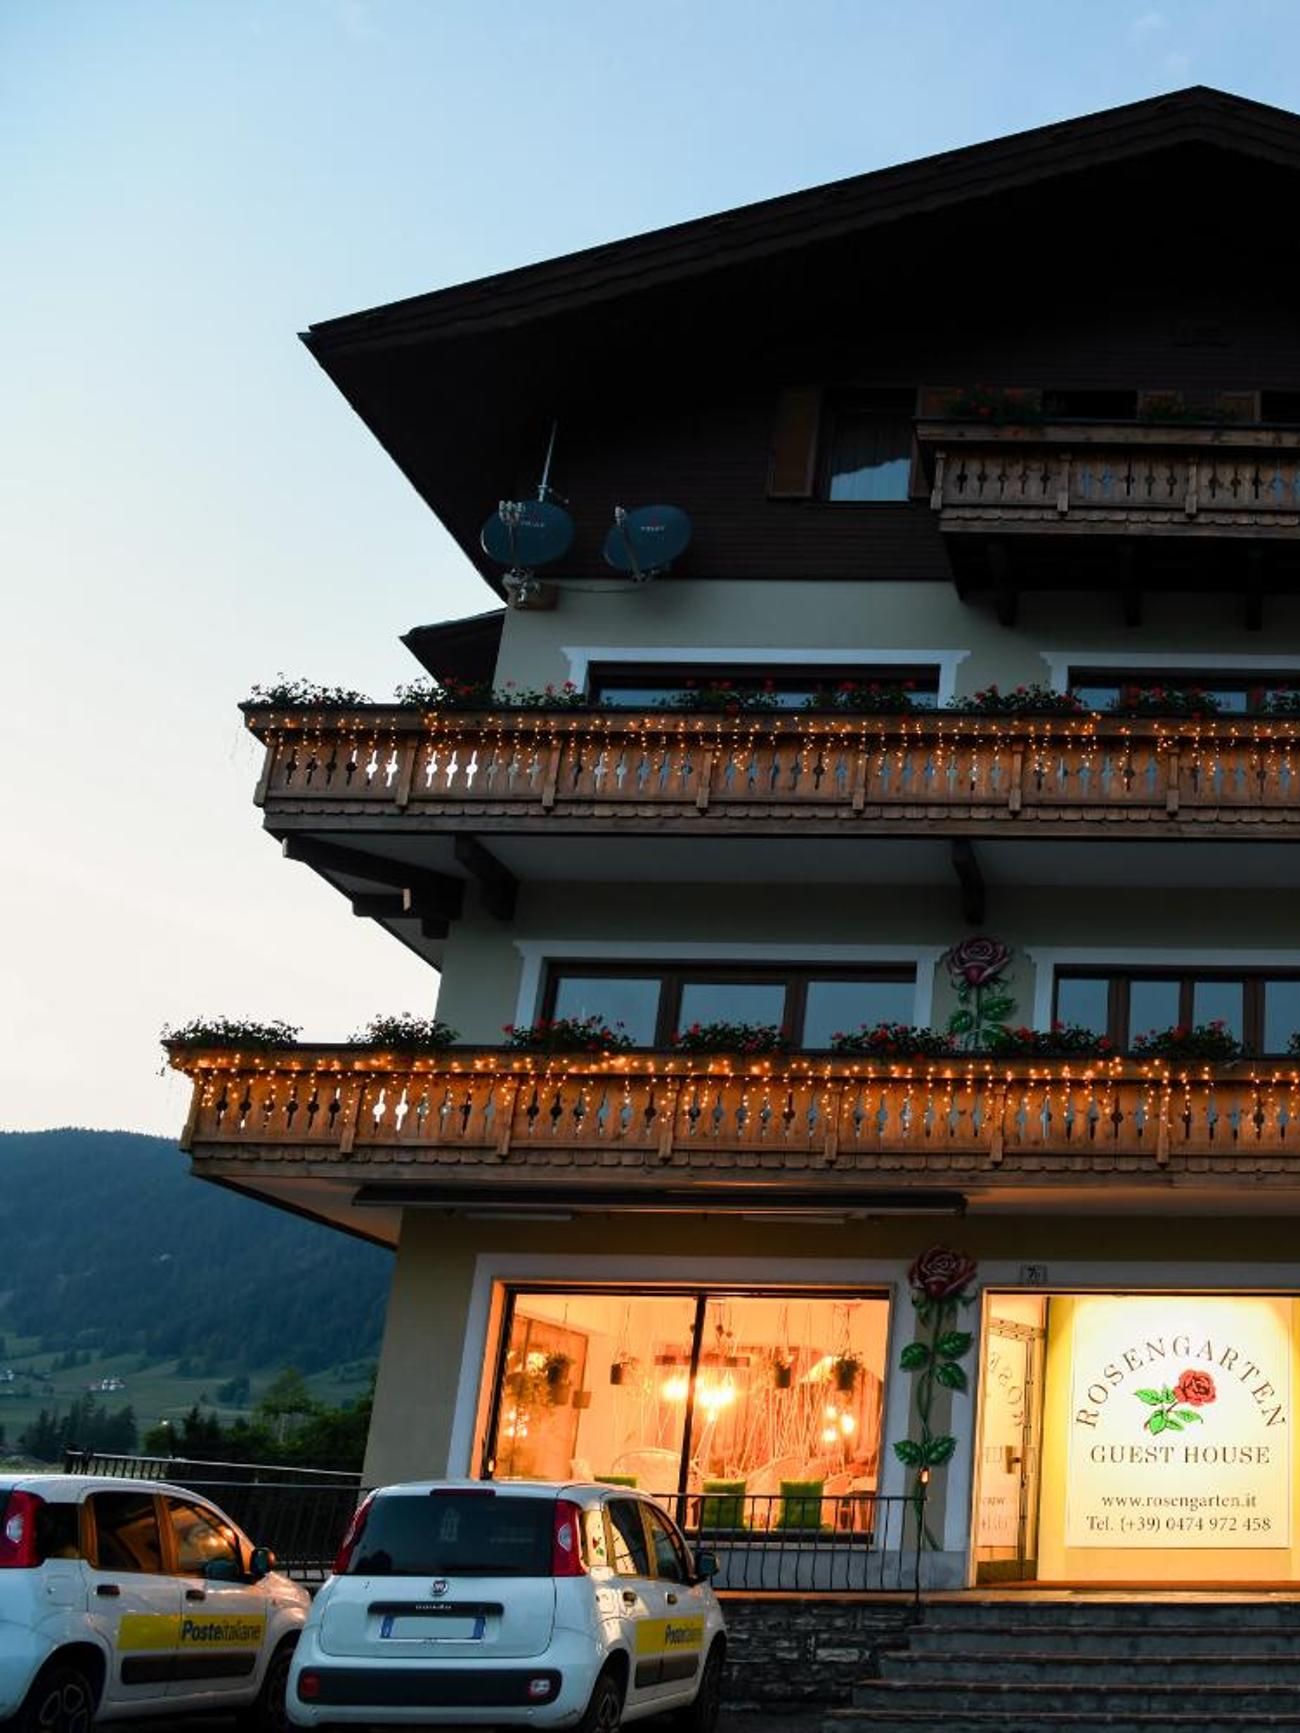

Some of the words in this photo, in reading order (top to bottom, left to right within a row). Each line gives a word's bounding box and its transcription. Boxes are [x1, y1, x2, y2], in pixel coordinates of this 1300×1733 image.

[1075, 1335, 1286, 1429] ROSENGARTEN
[1090, 1445, 1174, 1464] GUEST
[1184, 1445, 1270, 1464] HOUSE
[1101, 1493, 1257, 1511] www.rosengarten.it
[1086, 1516, 1113, 1532] Tel.
[1121, 1516, 1161, 1533] (+39)
[1166, 1517, 1203, 1532] 0474
[1209, 1517, 1237, 1532] 972
[1242, 1517, 1271, 1532] 458
